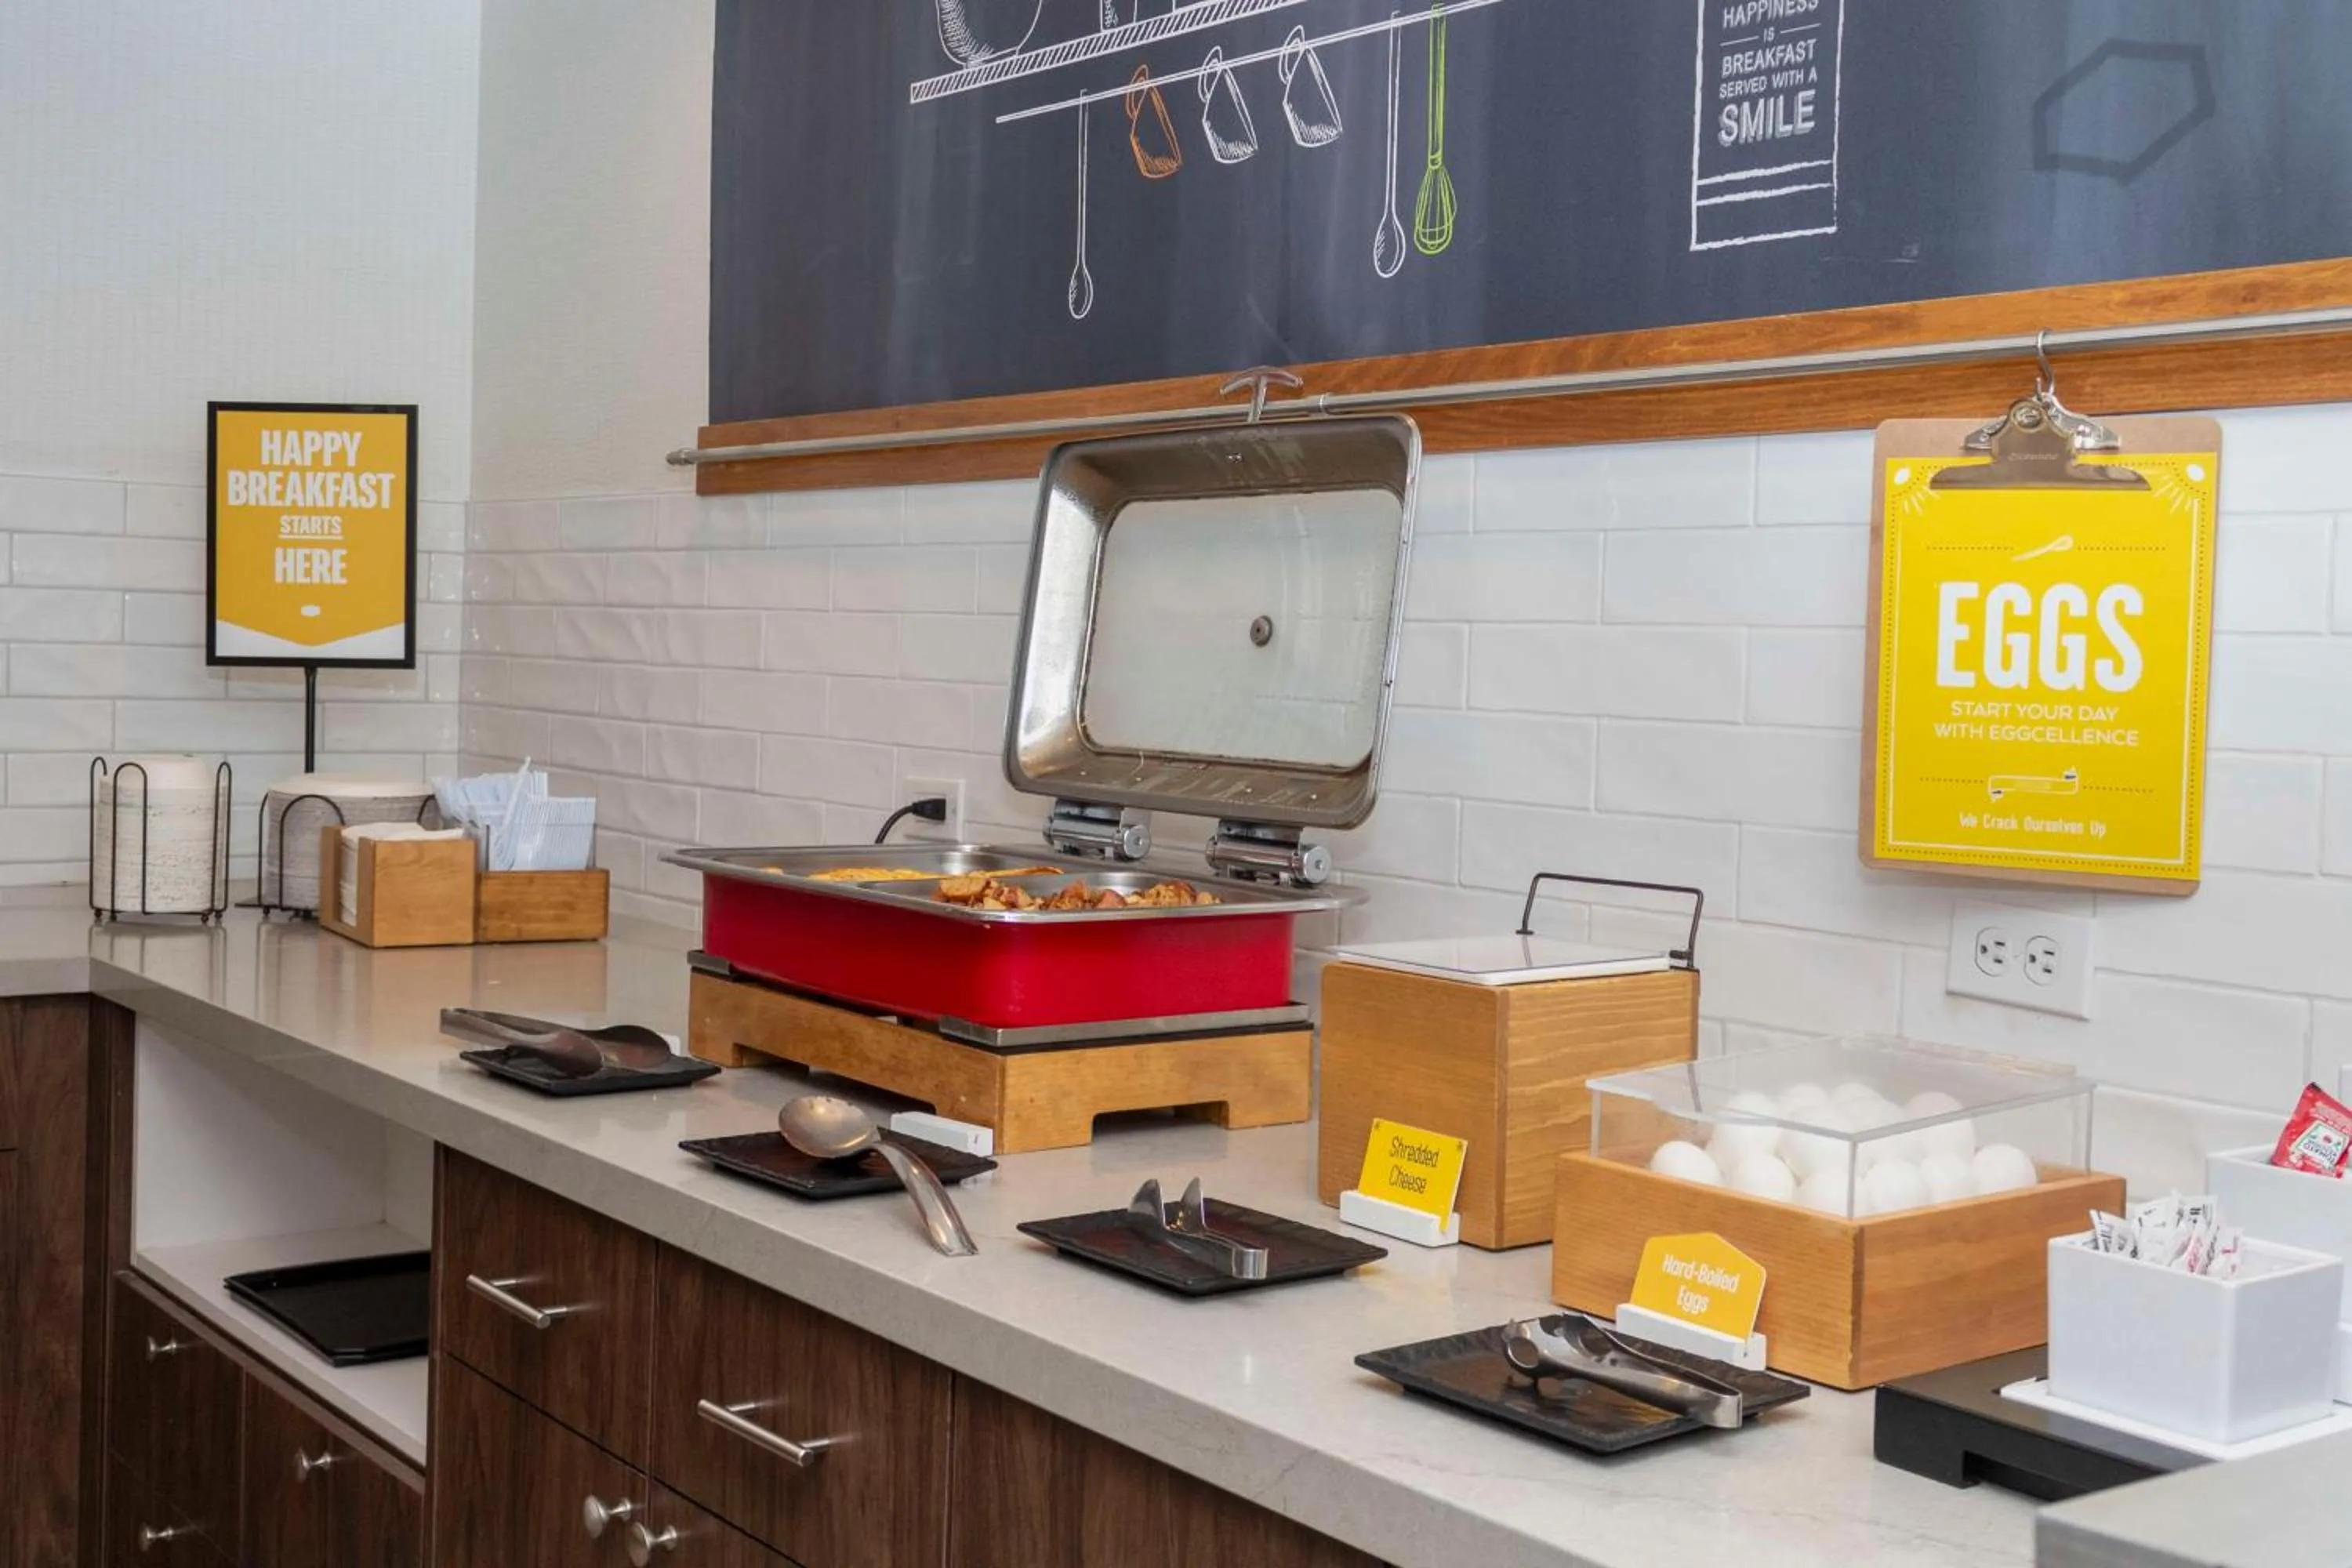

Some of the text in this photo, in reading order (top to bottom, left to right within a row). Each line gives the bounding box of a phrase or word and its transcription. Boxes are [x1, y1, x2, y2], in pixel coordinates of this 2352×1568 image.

[1722, 0, 1819, 29] HAPPINESS
[1763, 26, 1775, 43] IS
[1722, 38, 1817, 78] BREAKFAST
[1719, 66, 1818, 99] SERVED WITH A
[1718, 89, 1817, 147] SMILE
[260, 429, 363, 467] HAPPY
[227, 470, 396, 509] BREAKFAST
[280, 515, 342, 535] STARTS
[274, 546, 348, 585] HERE
[1936, 581, 2144, 692] EGGS
[1950, 700, 2120, 722] START YOUR DAY
[1933, 722, 2140, 747] WITH EGGCELLENCE
[1959, 811, 1977, 829] We
[1982, 812, 2019, 830] Crack
[2089, 819, 2107, 839] Up
[1390, 1135, 1440, 1168] Shredded
[1389, 1164, 1428, 1194] Cheese
[1663, 1254, 1740, 1294] Hard-Boiled
[1677, 1285, 1709, 1315] Eggs
